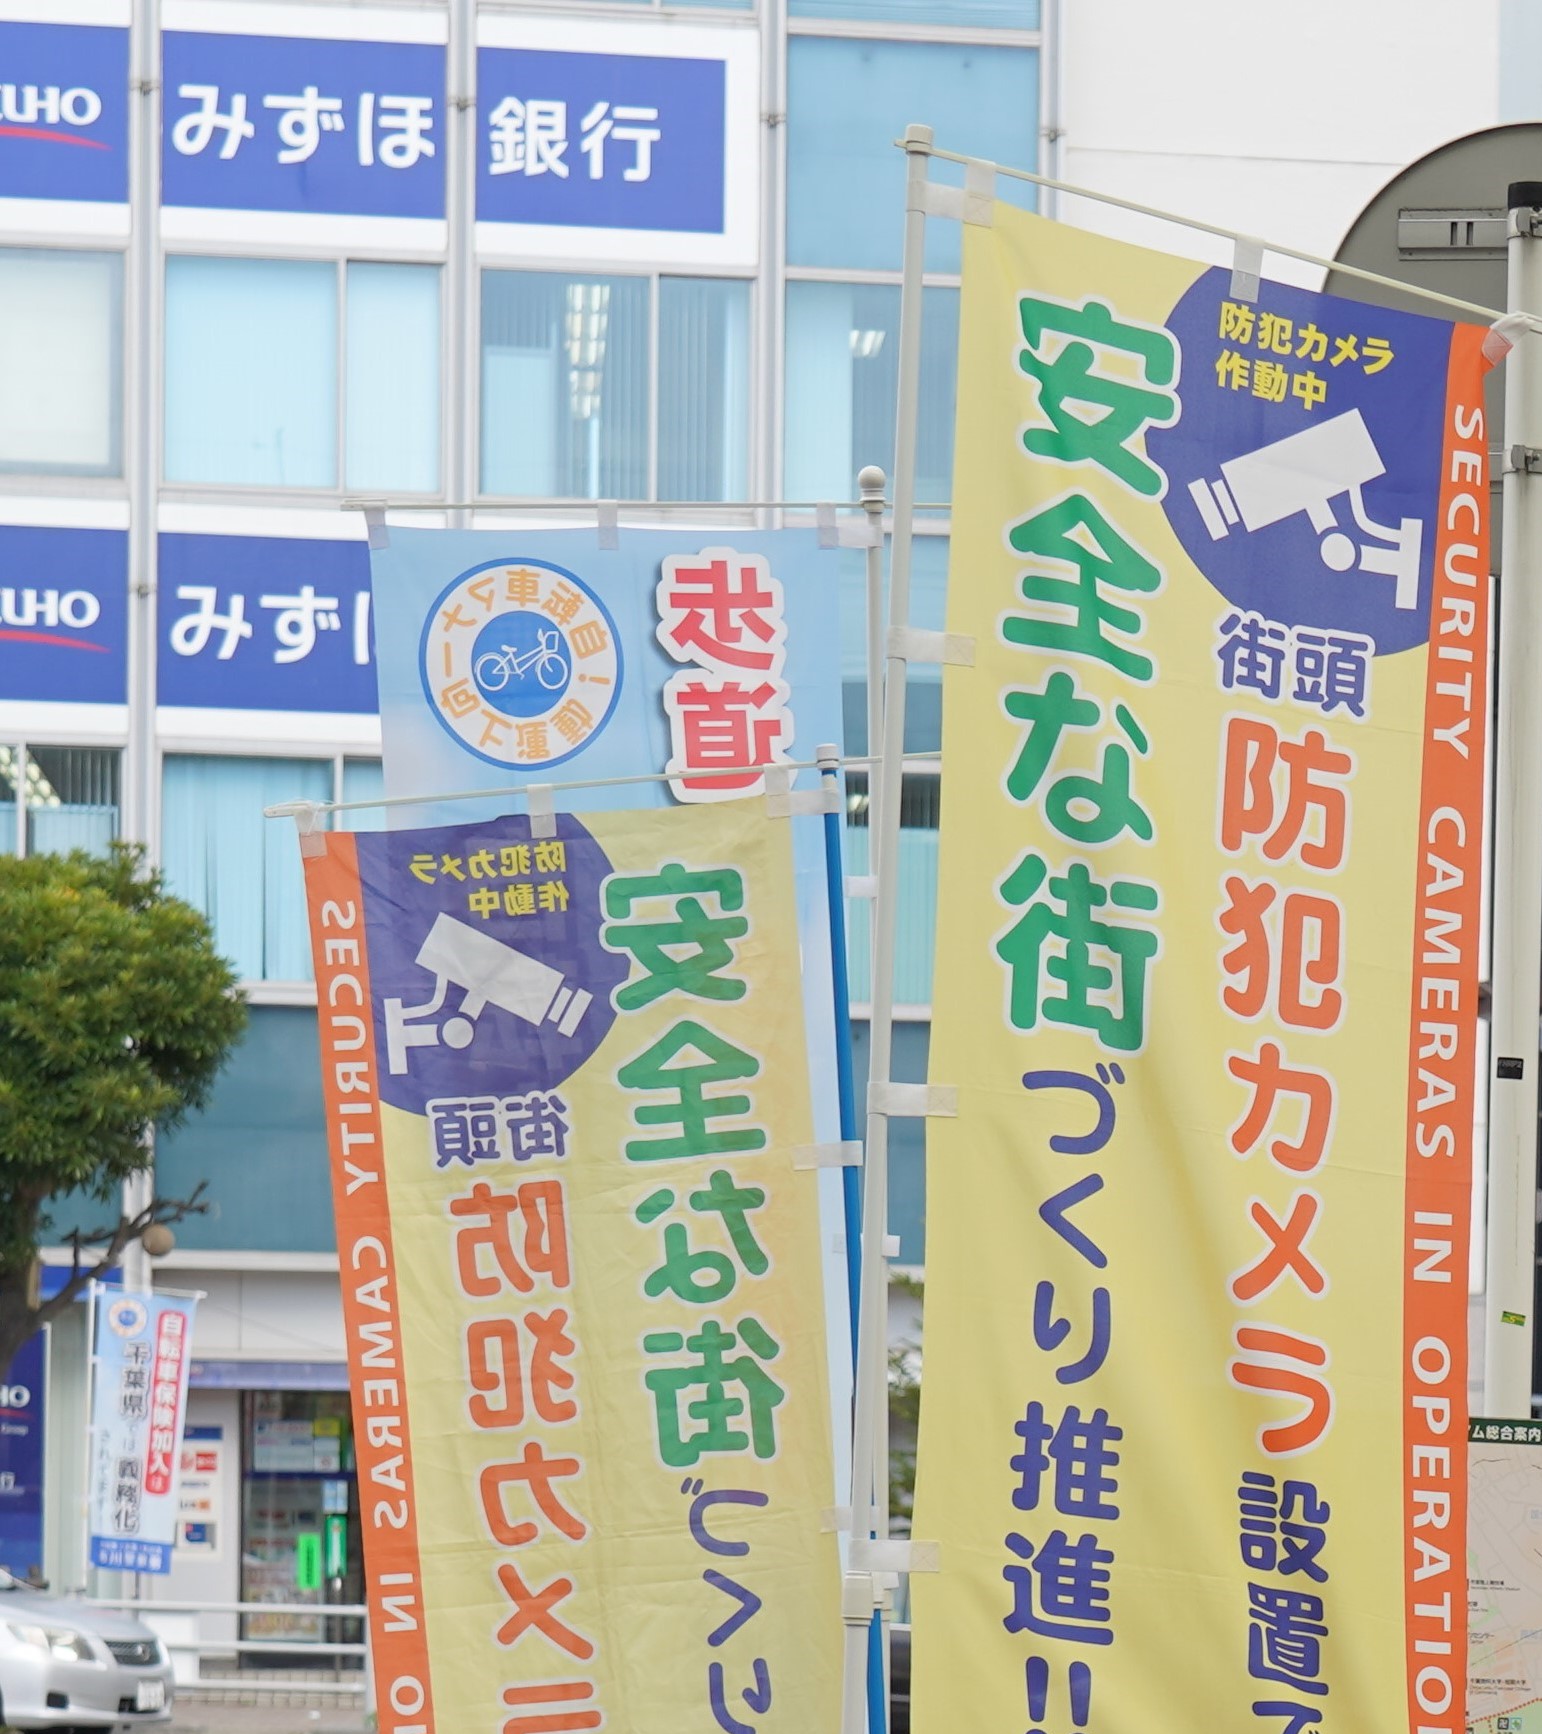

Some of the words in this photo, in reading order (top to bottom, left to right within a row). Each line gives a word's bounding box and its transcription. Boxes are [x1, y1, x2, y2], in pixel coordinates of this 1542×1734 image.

[0, 83, 102, 128] UHO
[172, 84, 436, 168] みずほ
[488, 95, 662, 183] 銀行
[1219, 301, 1395, 376] 防犯カメラ
[1215, 351, 1328, 411] 作動中
[0, 587, 101, 629] UHO
[1433, 404, 1484, 759] SECURITY
[1215, 611, 1368, 718] 街頭
[1412, 806, 1468, 1159] CAMERAS
[1412, 1210, 1454, 1283] IN
